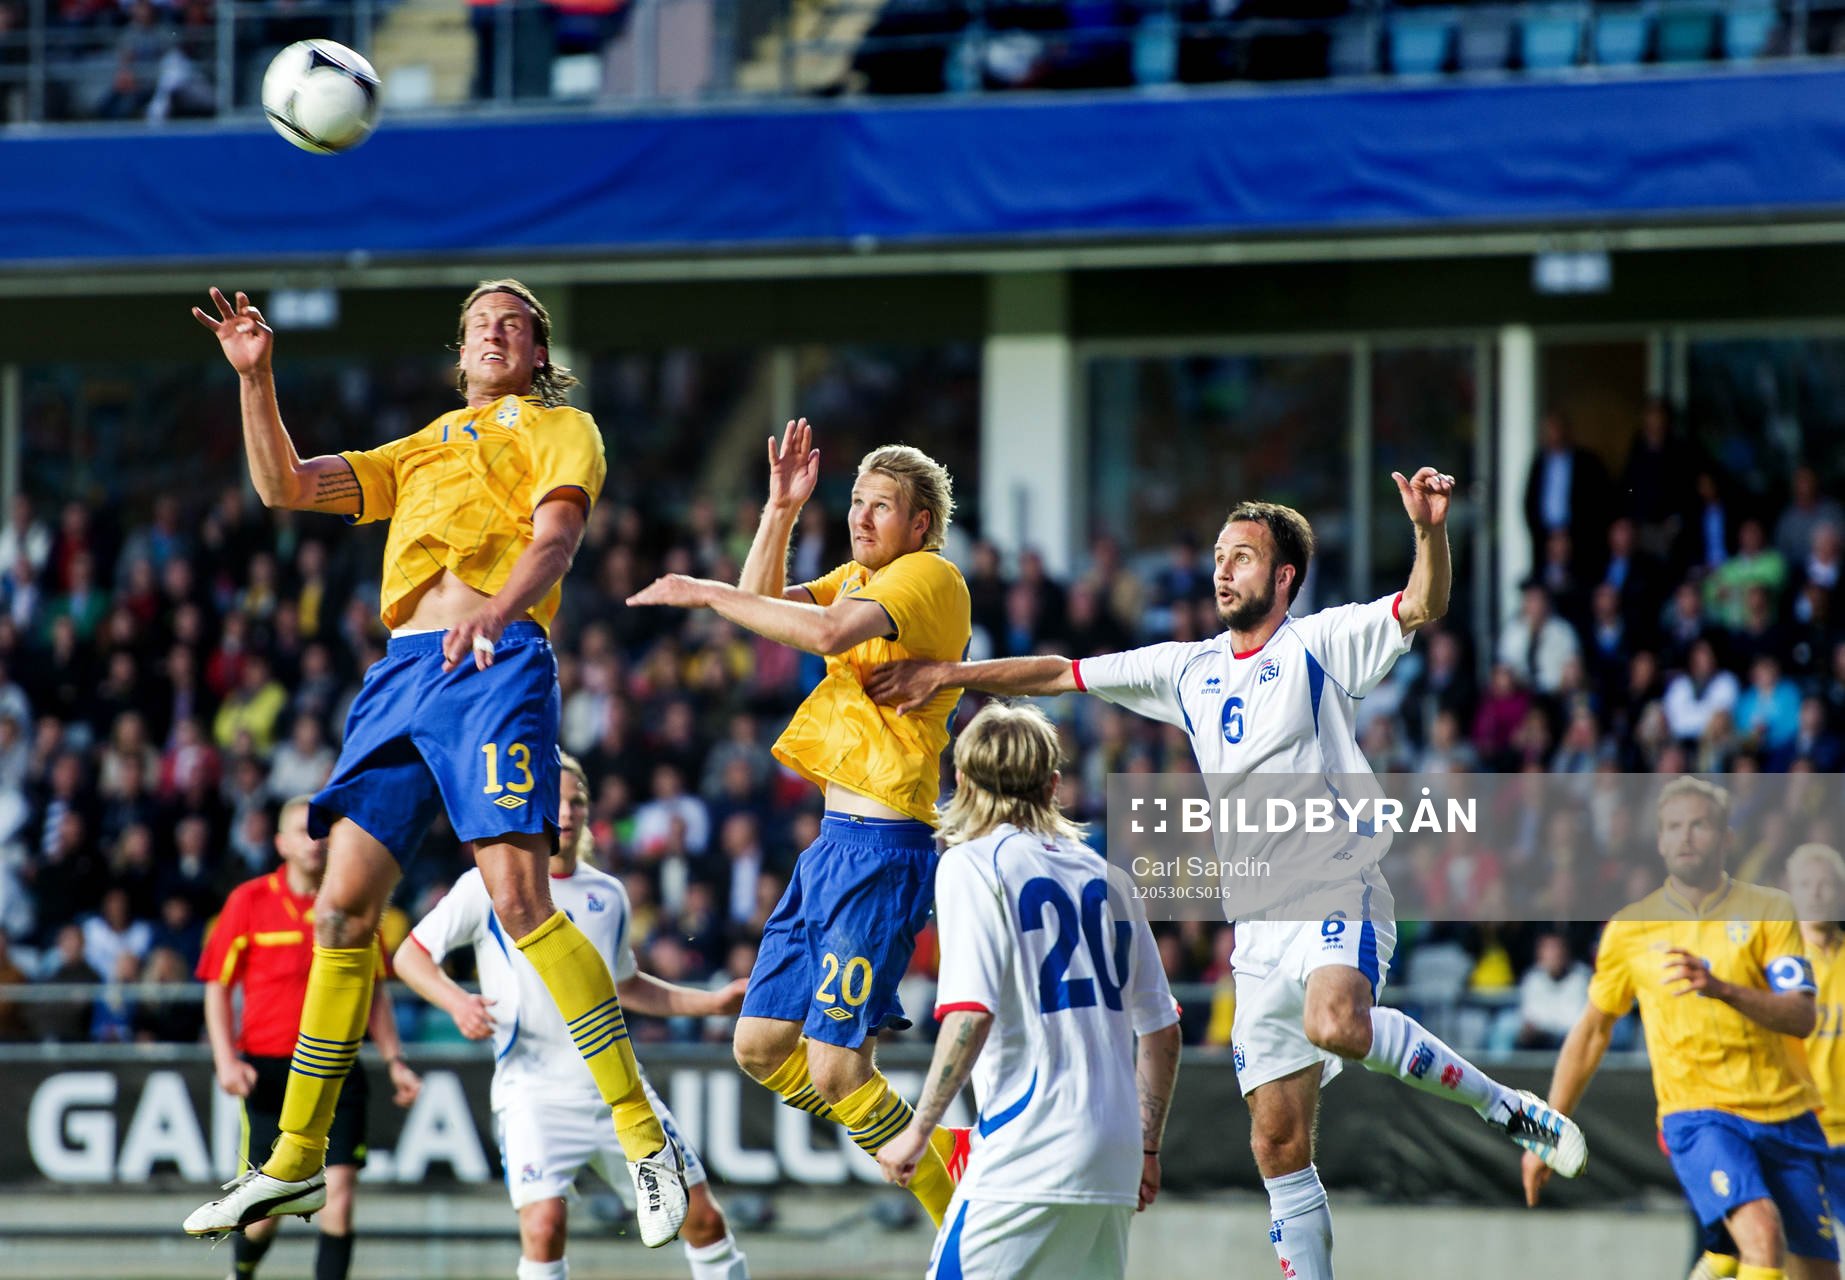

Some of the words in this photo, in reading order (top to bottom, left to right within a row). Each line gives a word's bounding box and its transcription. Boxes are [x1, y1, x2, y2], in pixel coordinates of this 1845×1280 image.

[1221, 696, 1245, 744] 6
[481, 742, 535, 794] 13
[1018, 876, 1133, 1014] 20
[1321, 910, 1348, 936] 6
[815, 952, 873, 1006] 20
